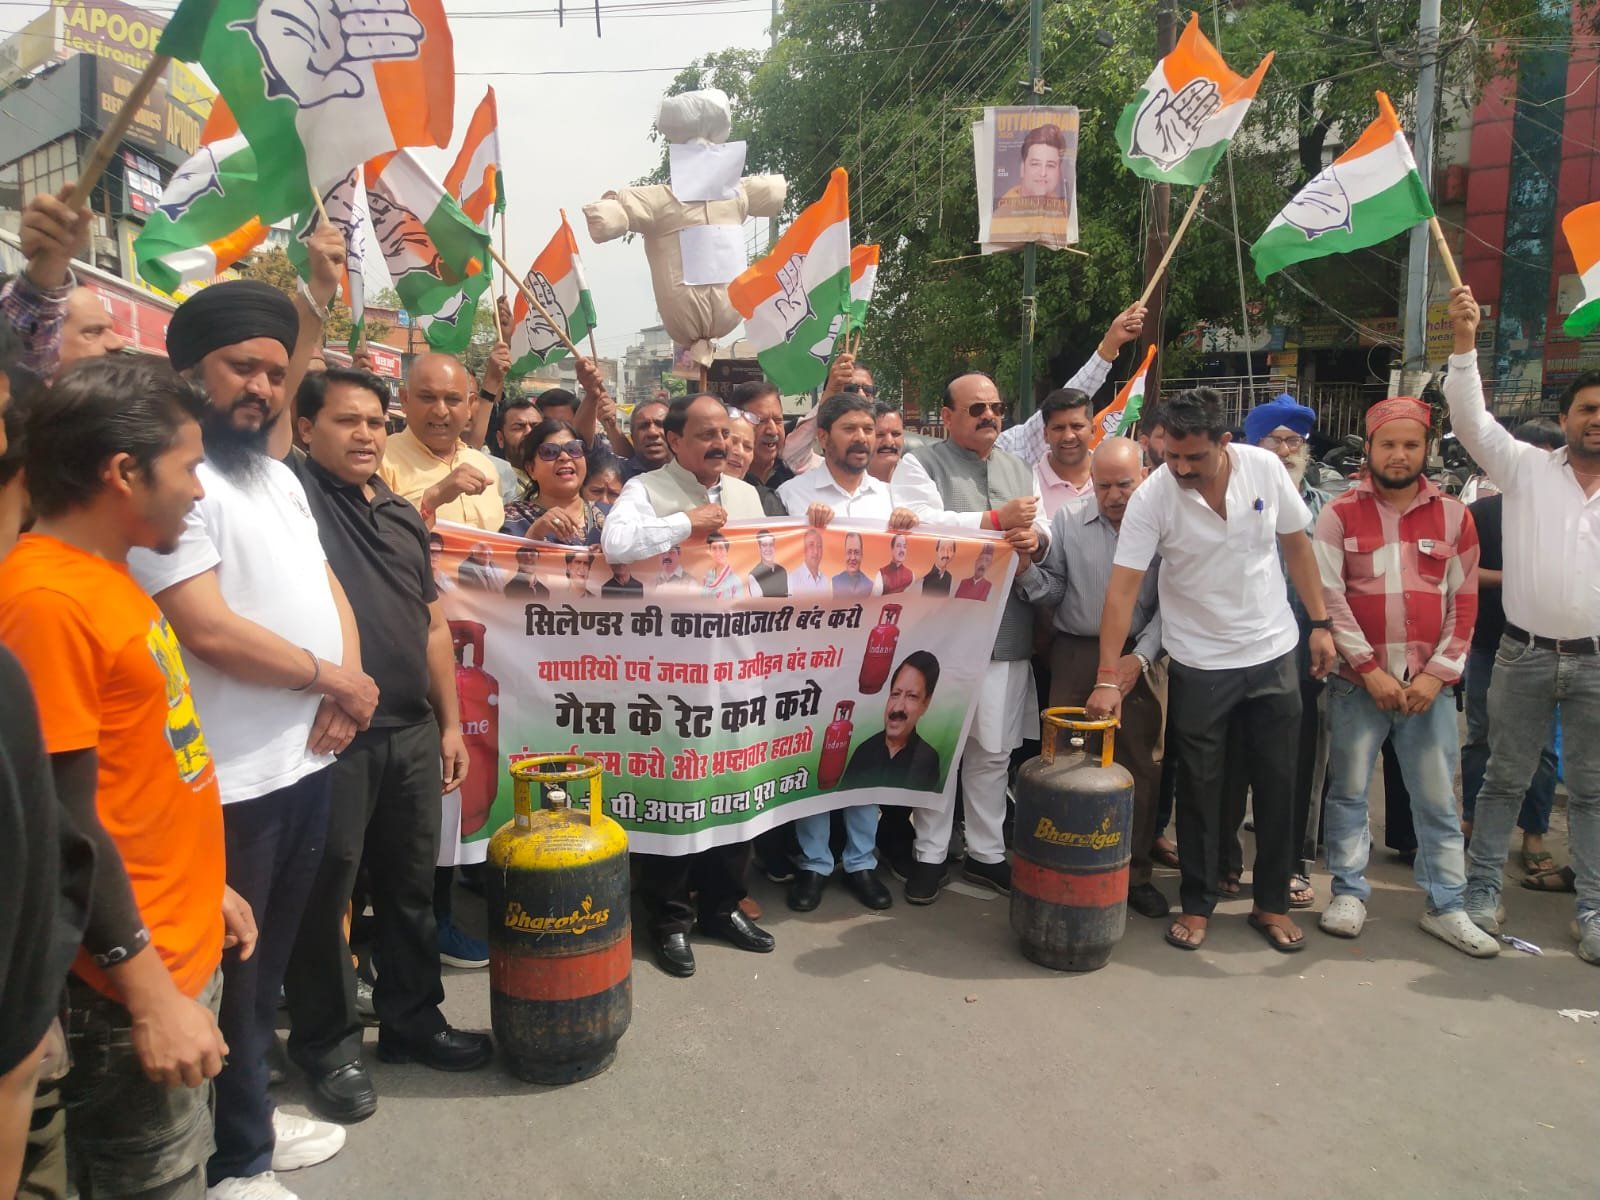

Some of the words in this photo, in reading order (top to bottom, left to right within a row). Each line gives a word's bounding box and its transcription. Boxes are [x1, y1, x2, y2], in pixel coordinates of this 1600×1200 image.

[525, 604, 623, 636] सिलेण्डर
[631, 605, 663, 637] की
[671, 606, 794, 639] कालाबाजारी
[796, 605, 825, 630] बंद
[828, 604, 863, 629] करो
[625, 656, 654, 682] एवं
[657, 662, 709, 684] जनता
[714, 661, 733, 682] का
[787, 647, 807, 672] बंद
[554, 692, 616, 734] गैस
[627, 694, 663, 735] के
[667, 695, 714, 738] रेट
[721, 695, 767, 732] कम
[775, 679, 822, 721] करो
[628, 747, 665, 778] करो
[671, 749, 708, 780] और
[770, 726, 813, 760] हटाओ
[710, 791, 750, 815] वादा
[754, 780, 776, 811] पूरा
[779, 766, 809, 794] करो
[1034, 817, 1121, 849] Bharatgas
